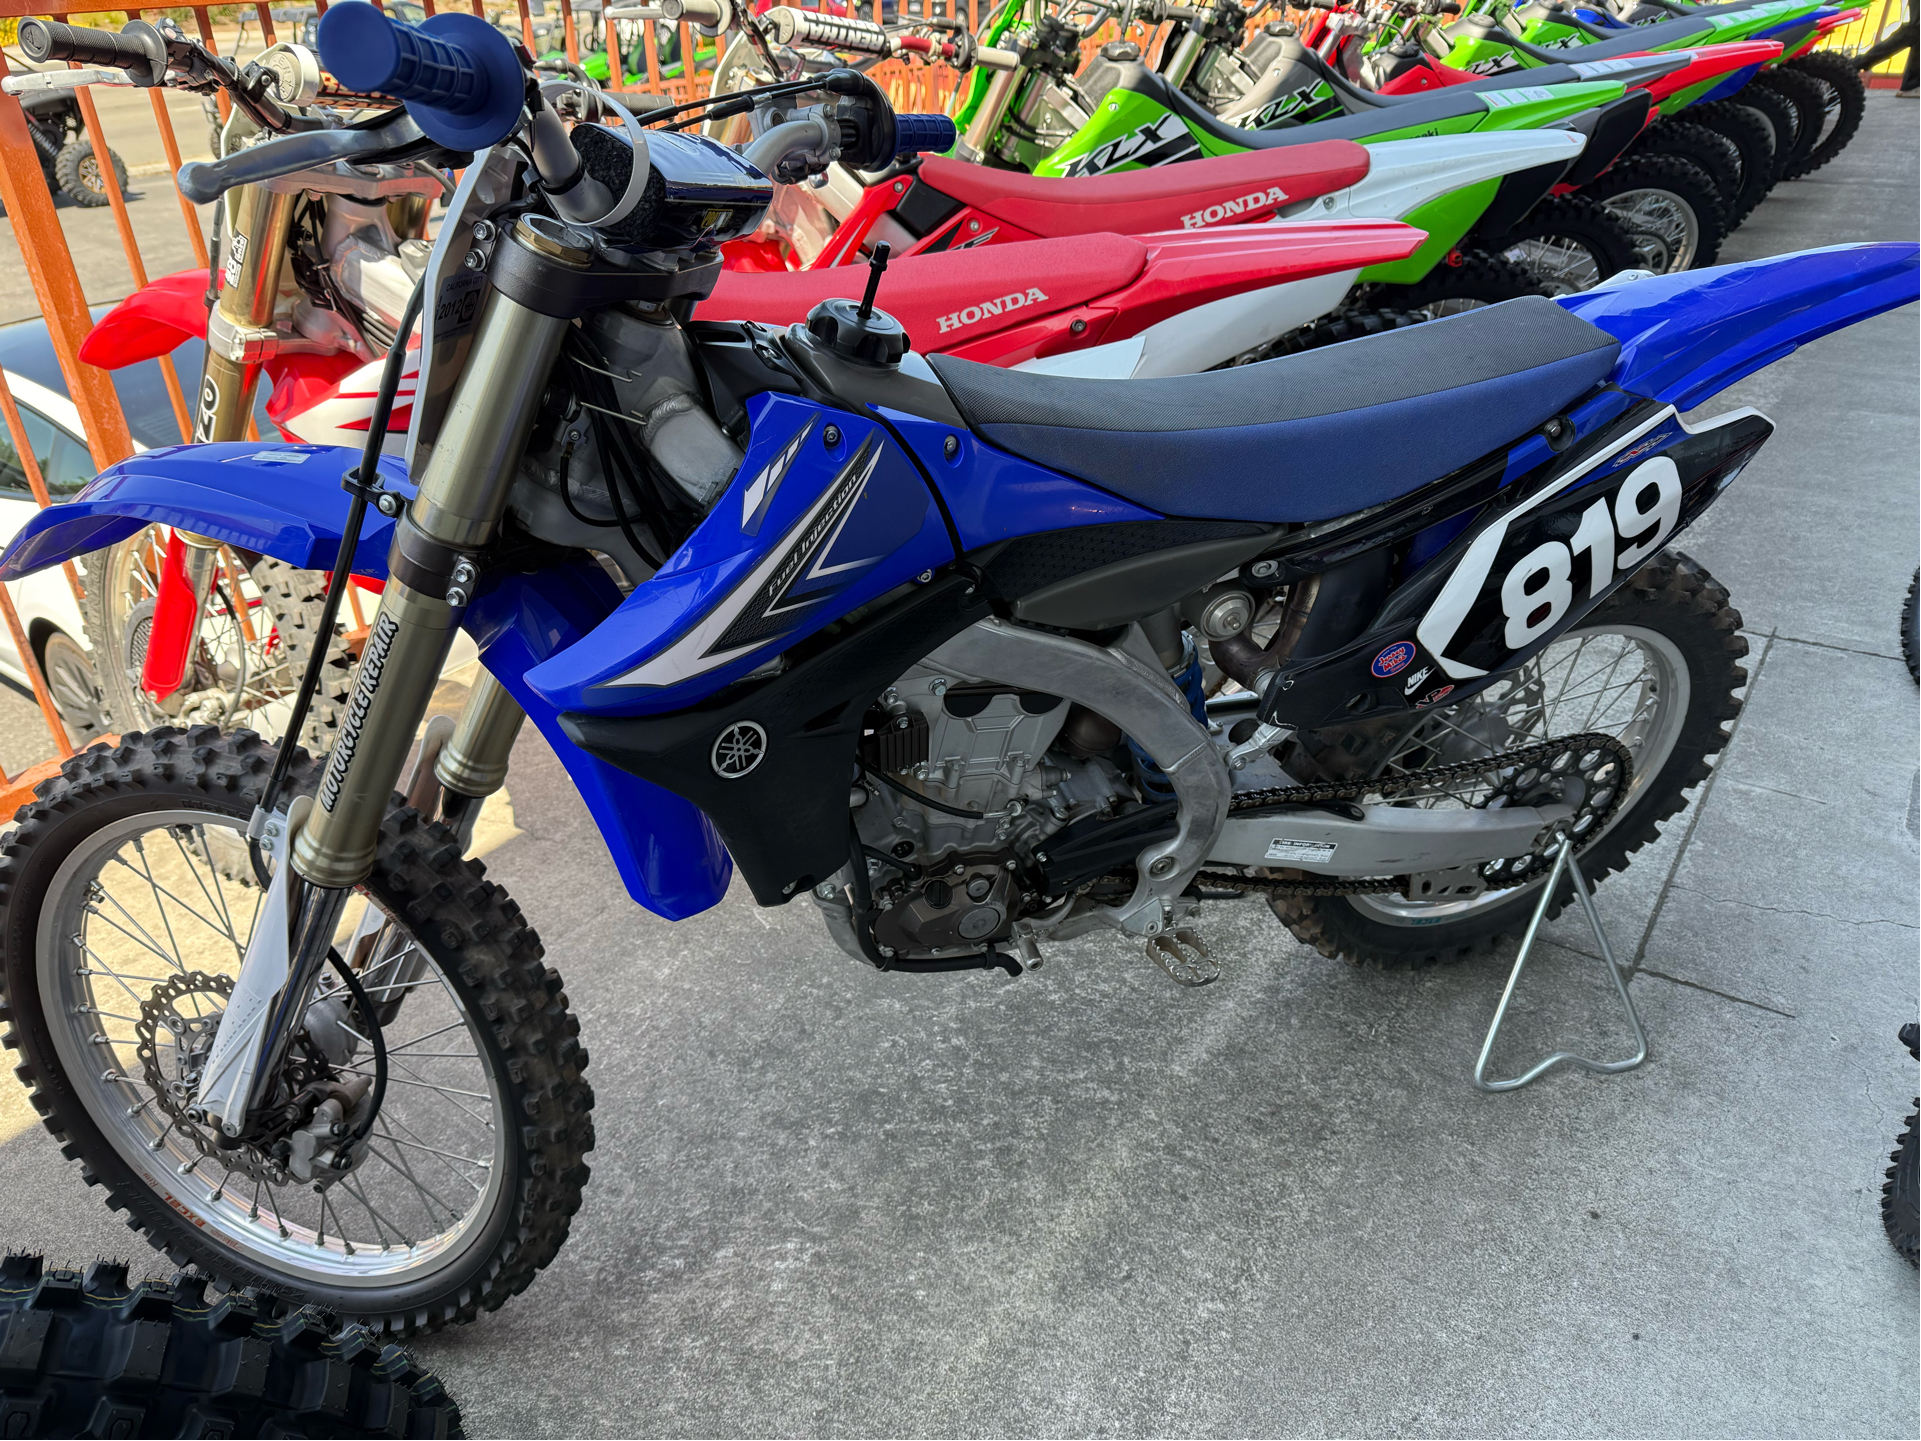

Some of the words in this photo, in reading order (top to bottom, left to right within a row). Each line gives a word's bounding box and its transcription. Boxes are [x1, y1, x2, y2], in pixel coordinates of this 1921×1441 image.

[1180, 186, 1289, 231] HONDA
[446, 279, 473, 292] CALIFORNIA
[472, 276, 484, 285] CITY
[438, 299, 463, 321] 2012
[936, 287, 1049, 334] HONDA
[768, 550, 801, 597] Fuel
[800, 473, 859, 557] Injection
[1501, 455, 1684, 650] 819
[1407, 665, 1429, 687] NIKE
[319, 683, 373, 813] MOTORCYCLE
[360, 611, 400, 694] REPAIR
[142, 1172, 159, 1189] Rim
[163, 1191, 207, 1229] EXCEL
